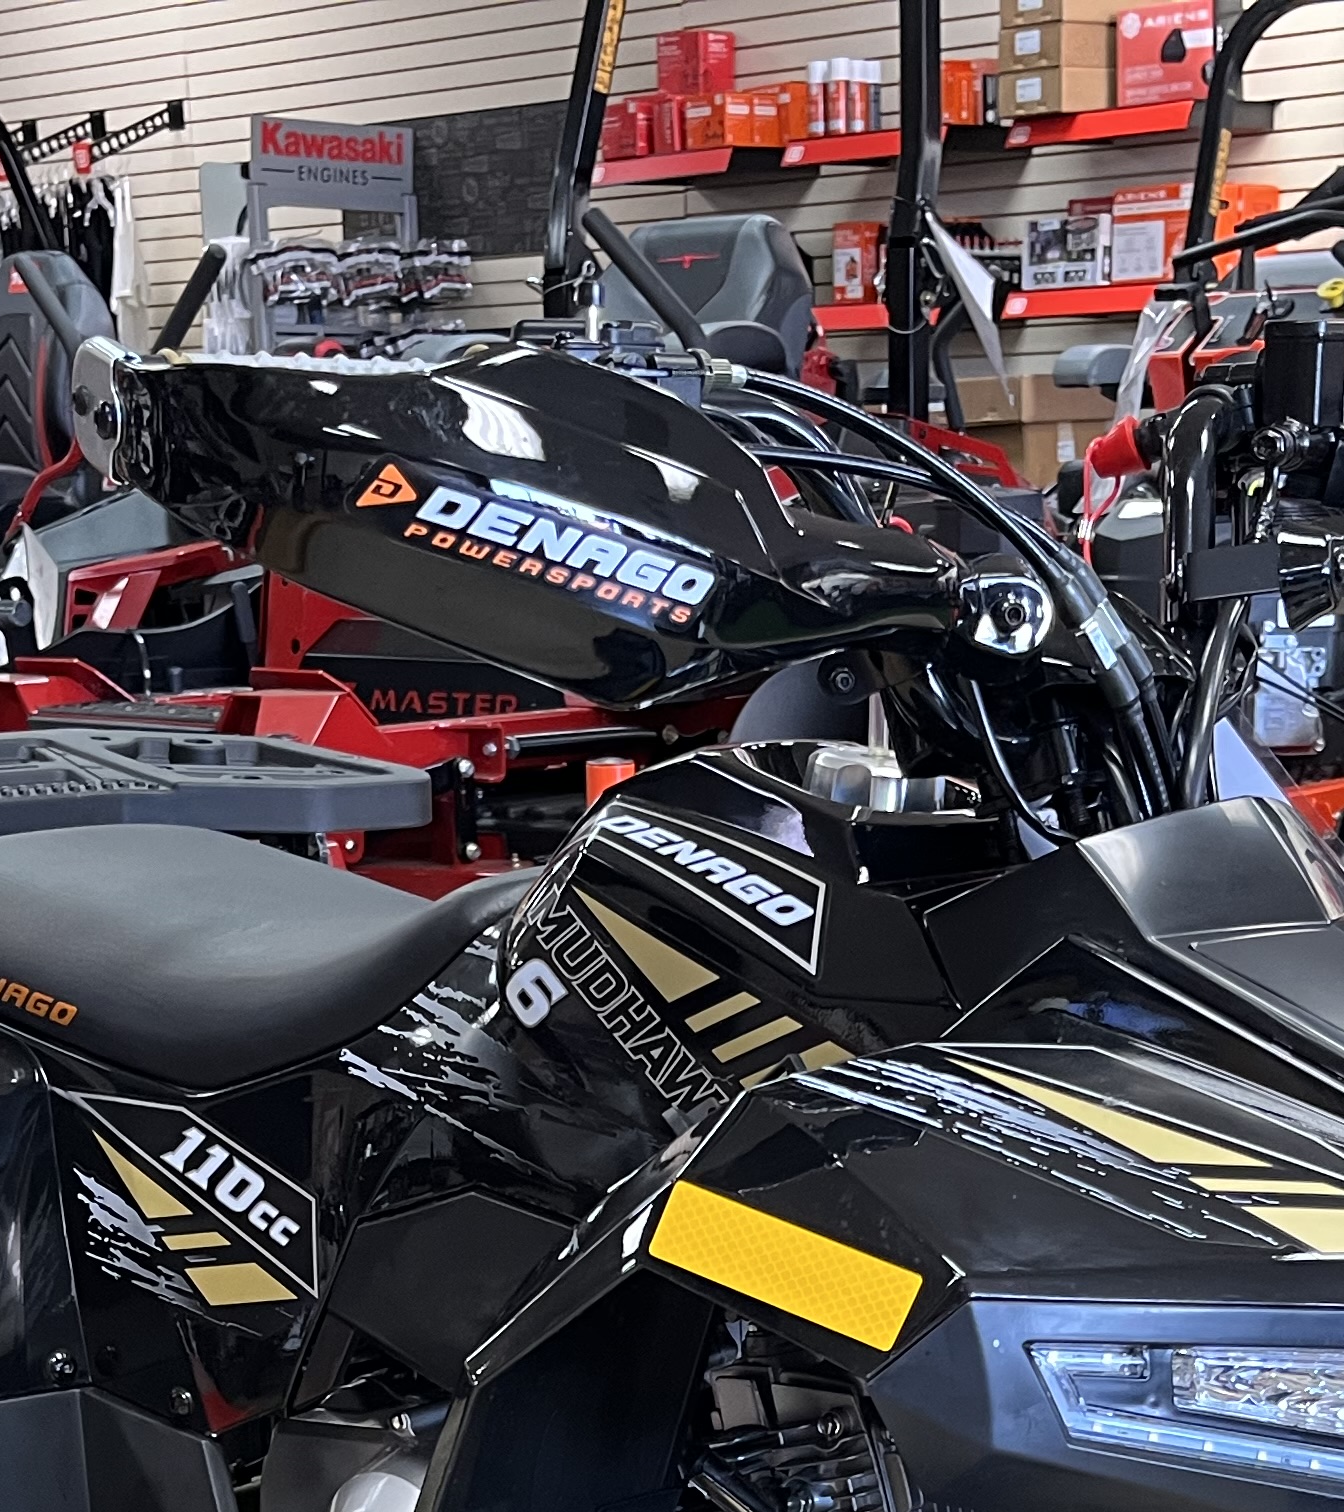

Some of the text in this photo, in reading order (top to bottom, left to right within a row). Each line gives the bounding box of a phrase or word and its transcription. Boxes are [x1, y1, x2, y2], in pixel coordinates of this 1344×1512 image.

[261, 120, 404, 166] Kawasaki
[297, 165, 369, 186] ENGINES
[403, 521, 693, 625] POWERSPORTS
[415, 485, 718, 606] DENAGO
[370, 688, 519, 716] MASTER
[597, 813, 814, 927] DENAGO
[506, 958, 569, 1029] 6
[160, 1126, 301, 1248] 110cc
